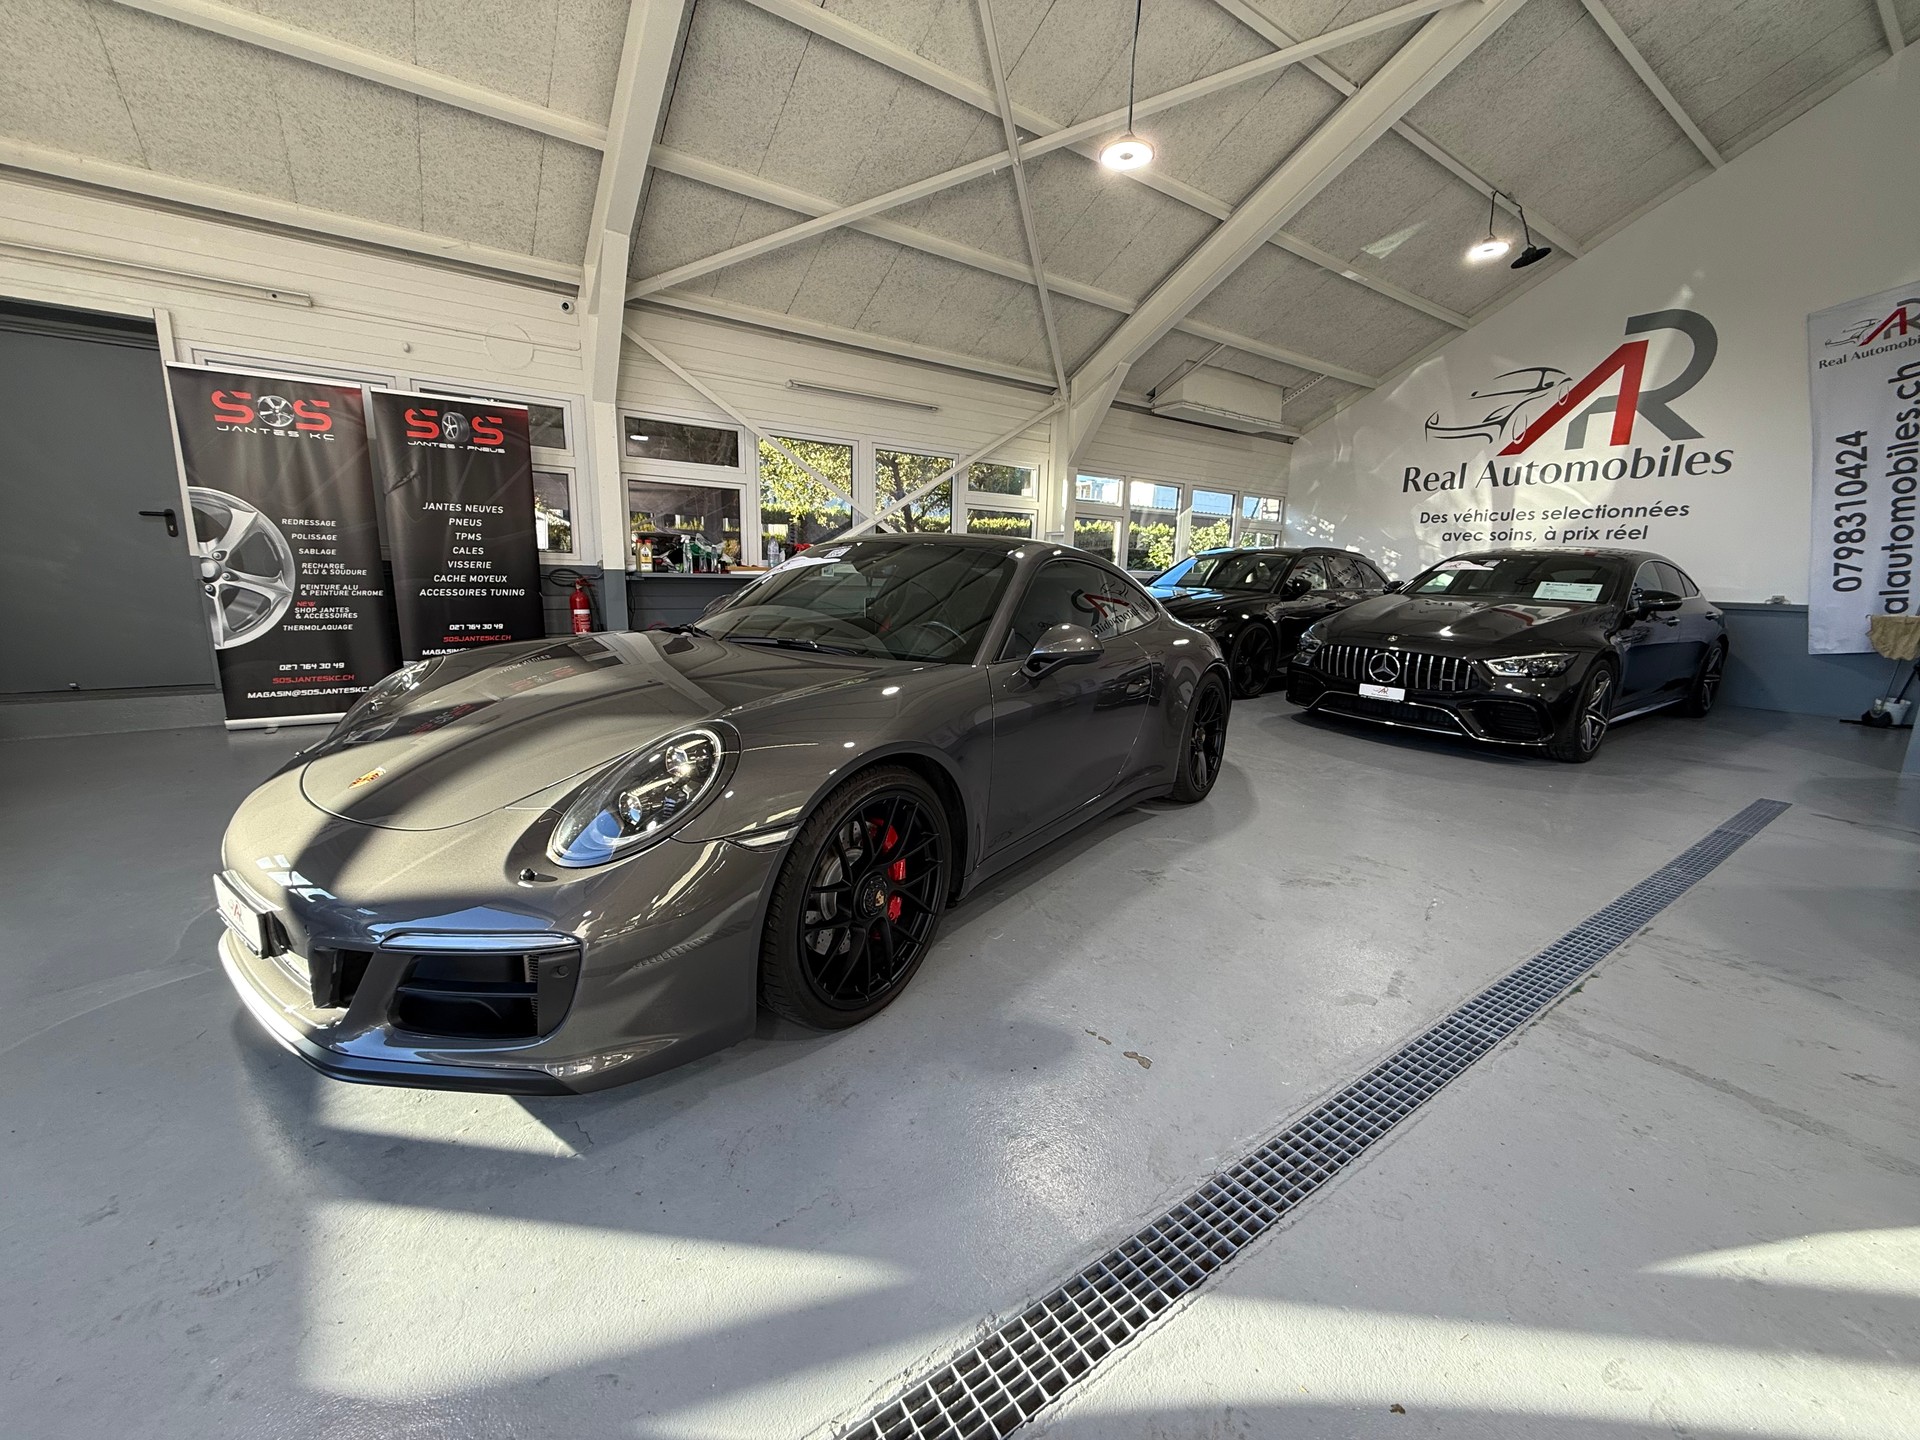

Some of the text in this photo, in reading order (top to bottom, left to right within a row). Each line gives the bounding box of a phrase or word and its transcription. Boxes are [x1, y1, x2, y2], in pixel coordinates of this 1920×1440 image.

[1818, 354, 1847, 370] Real
[216, 425, 335, 441] JANTES KC
[407, 440, 455, 449] JANTES
[467, 446, 506, 454] PNEUS
[1402, 444, 1734, 493] Real Automobiles
[422, 502, 504, 514] JANTES NEUVES
[1420, 500, 1690, 524] Des véhicules selectionnées
[1832, 430, 1868, 592] 0798310424
[281, 518, 336, 527] REDRESSAGE
[448, 518, 482, 527] PNEUS
[291, 533, 337, 541] POLISSAGE
[455, 532, 482, 540] TPMS
[1442, 523, 1649, 543] avec soins, à prix réel
[452, 546, 484, 554] CALES
[448, 560, 492, 569] VISSERIE
[434, 574, 466, 582] CACHE
[420, 588, 487, 596] ACCESSOIRES
[272, 674, 355, 684] SOSJANTESKC.CH
